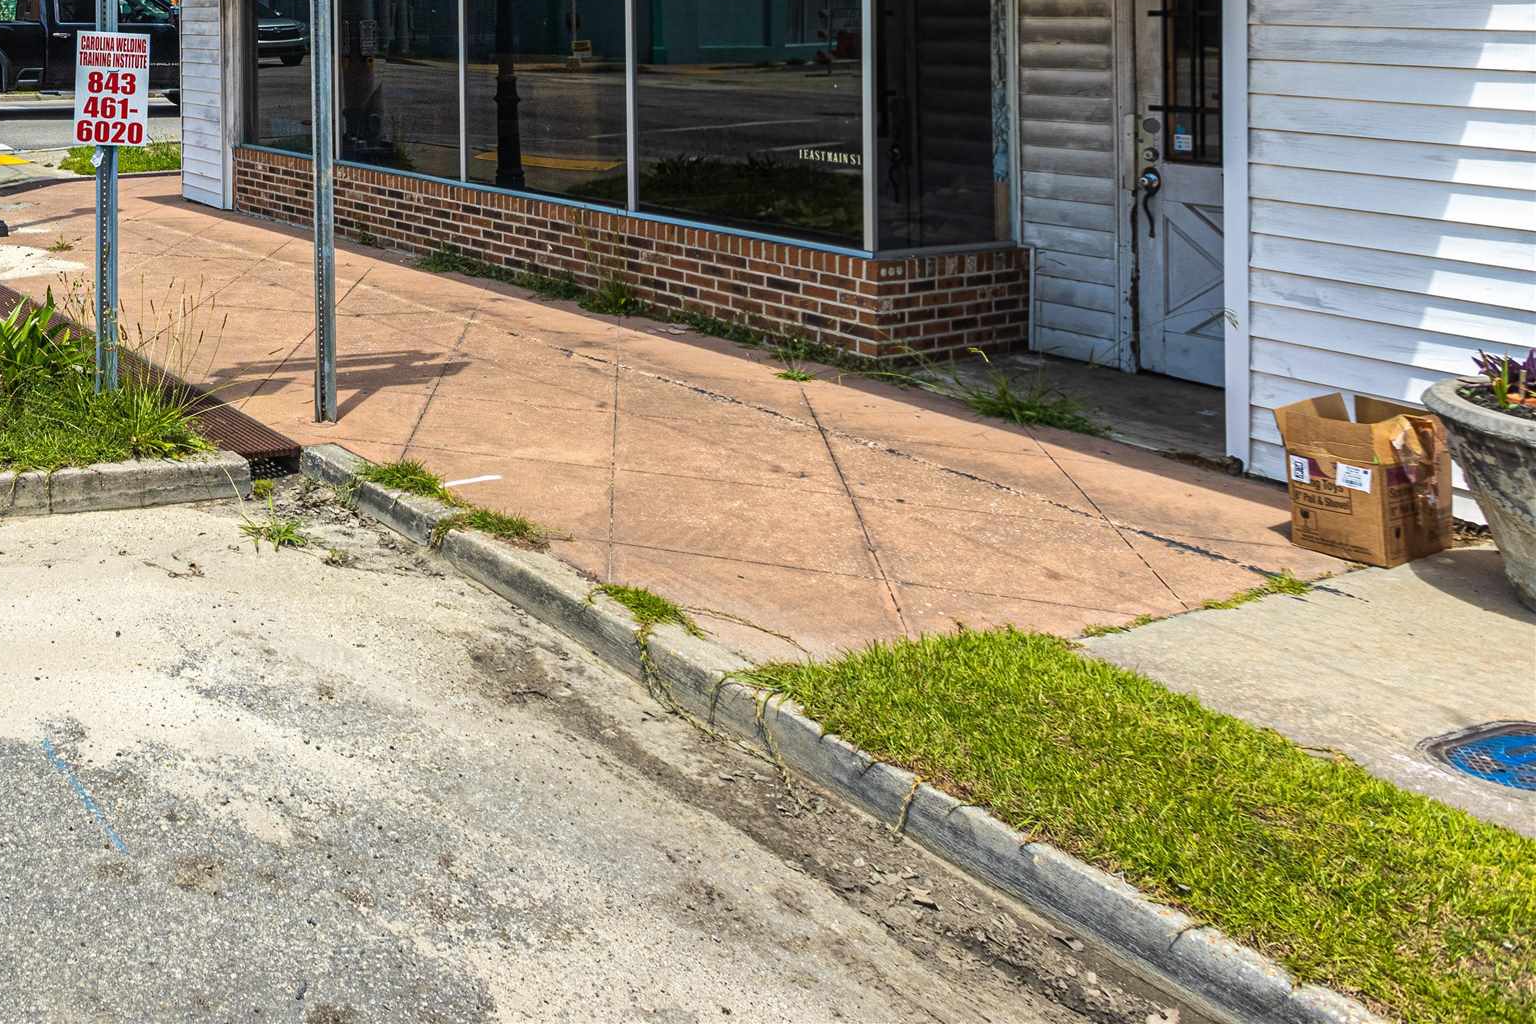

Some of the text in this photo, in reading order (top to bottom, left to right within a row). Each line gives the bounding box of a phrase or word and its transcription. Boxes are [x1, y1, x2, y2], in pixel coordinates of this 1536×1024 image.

[81, 36, 147, 53] CAROLINA WELDING
[80, 51, 147, 69] TRAINING INSTITUTE
[88, 72, 136, 95] 843
[83, 96, 138, 119] 461-
[76, 120, 143, 144] 6020
